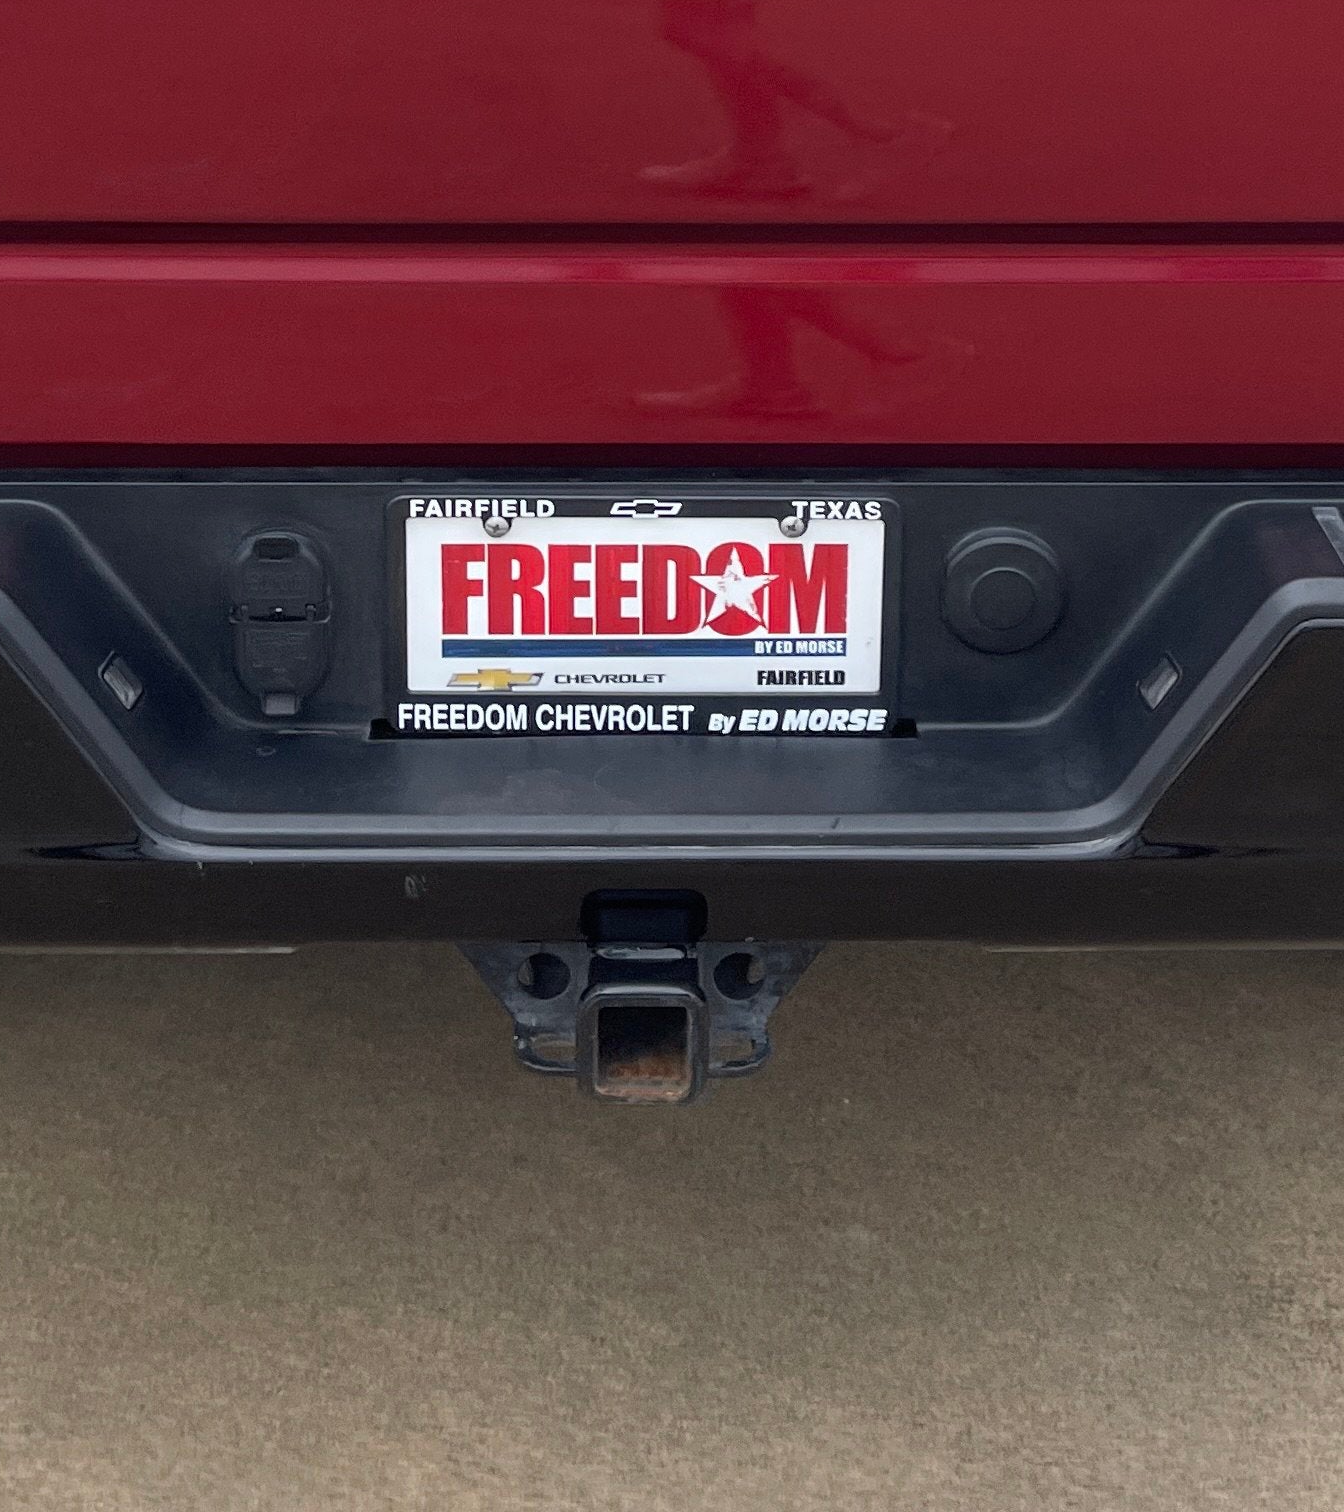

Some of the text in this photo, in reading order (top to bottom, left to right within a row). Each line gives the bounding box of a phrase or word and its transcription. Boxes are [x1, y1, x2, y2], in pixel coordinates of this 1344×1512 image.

[409, 499, 882, 520] FAIRFIELD TEXAS
[441, 542, 849, 636] FREEDOM
[754, 640, 844, 654] BY ED MORSE
[554, 673, 666, 684] CHEVROLET
[757, 669, 846, 686] FAIRFIELD
[398, 703, 888, 735] FREEDOM CHEVROLET By ED MORSE
